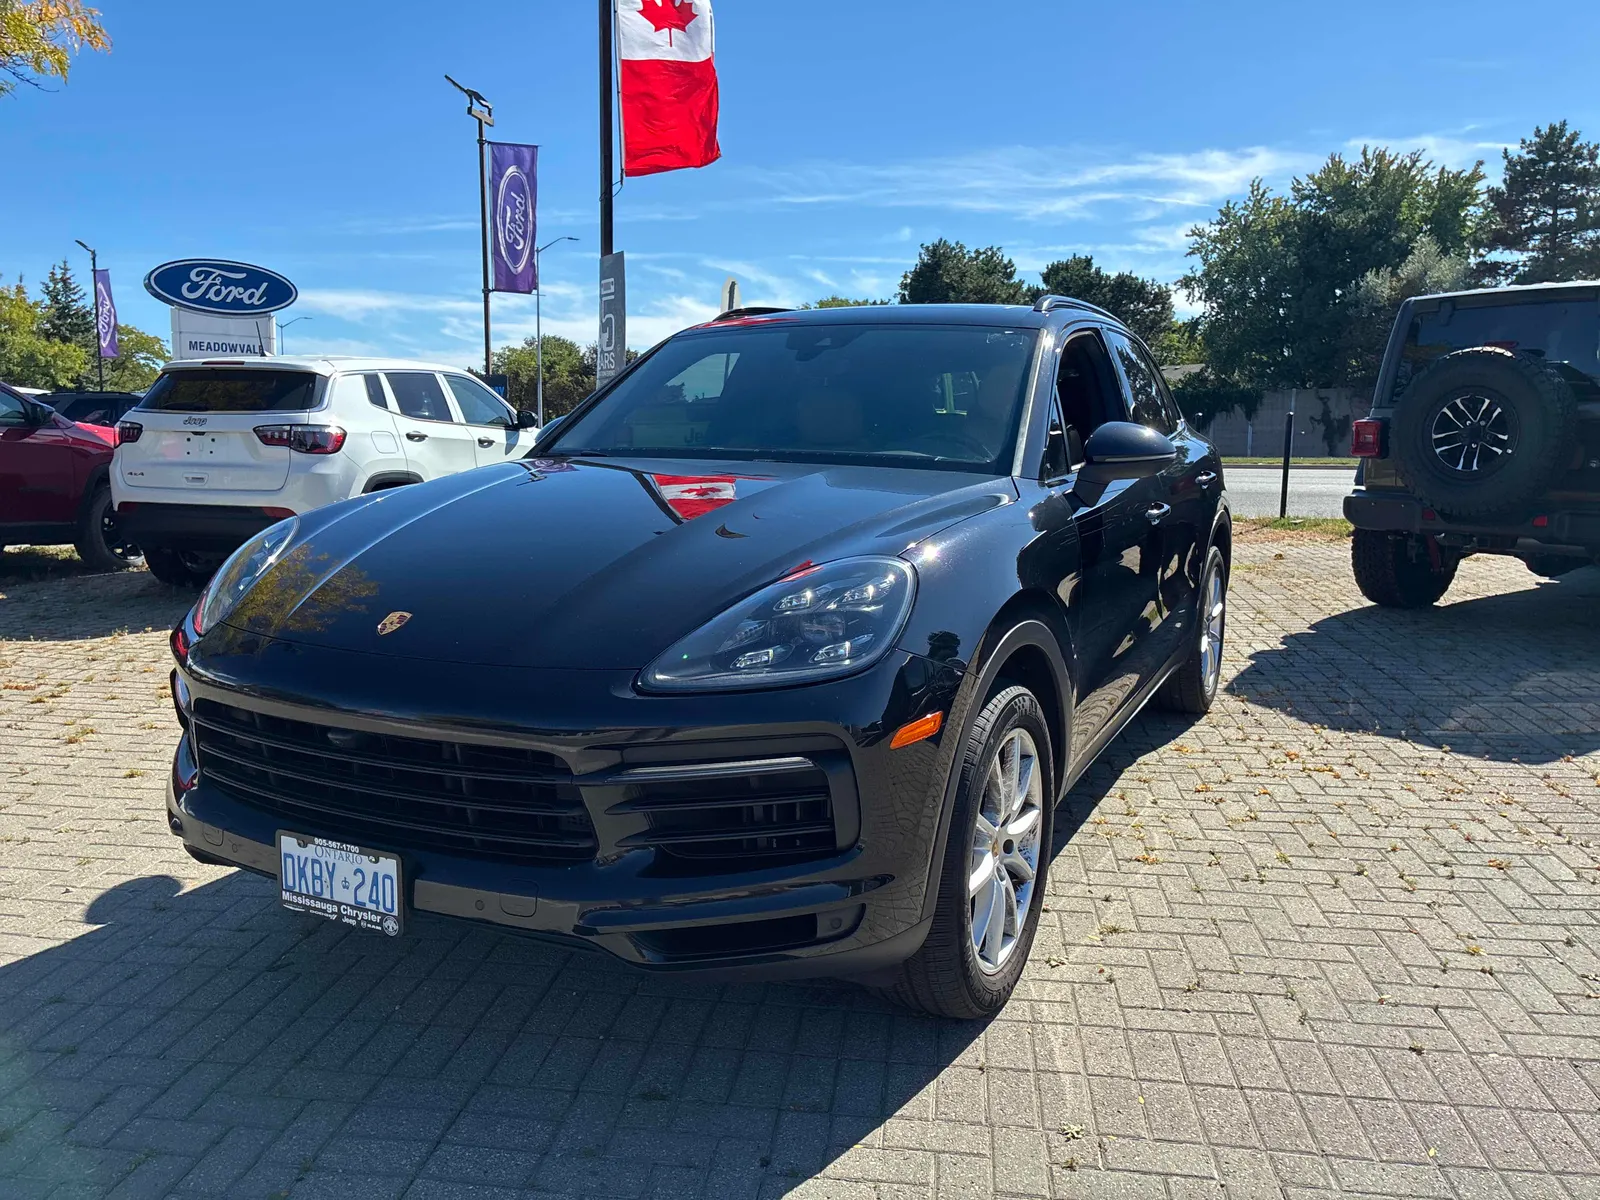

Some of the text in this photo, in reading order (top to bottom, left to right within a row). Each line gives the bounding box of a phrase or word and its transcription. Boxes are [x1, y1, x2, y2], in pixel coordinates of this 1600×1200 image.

[505, 191, 526, 250] Ford
[181, 266, 269, 305] Ford
[188, 340, 263, 355] MEADOWVALE
[183, 416, 208, 427] Jeep
[314, 837, 360, 854] 905-567-1700
[314, 845, 363, 865] ONTARIO
[283, 852, 395, 914] DKBY 240
[282, 890, 382, 923] Mississauga Chrysler
[341, 916, 357, 927] Jeep
